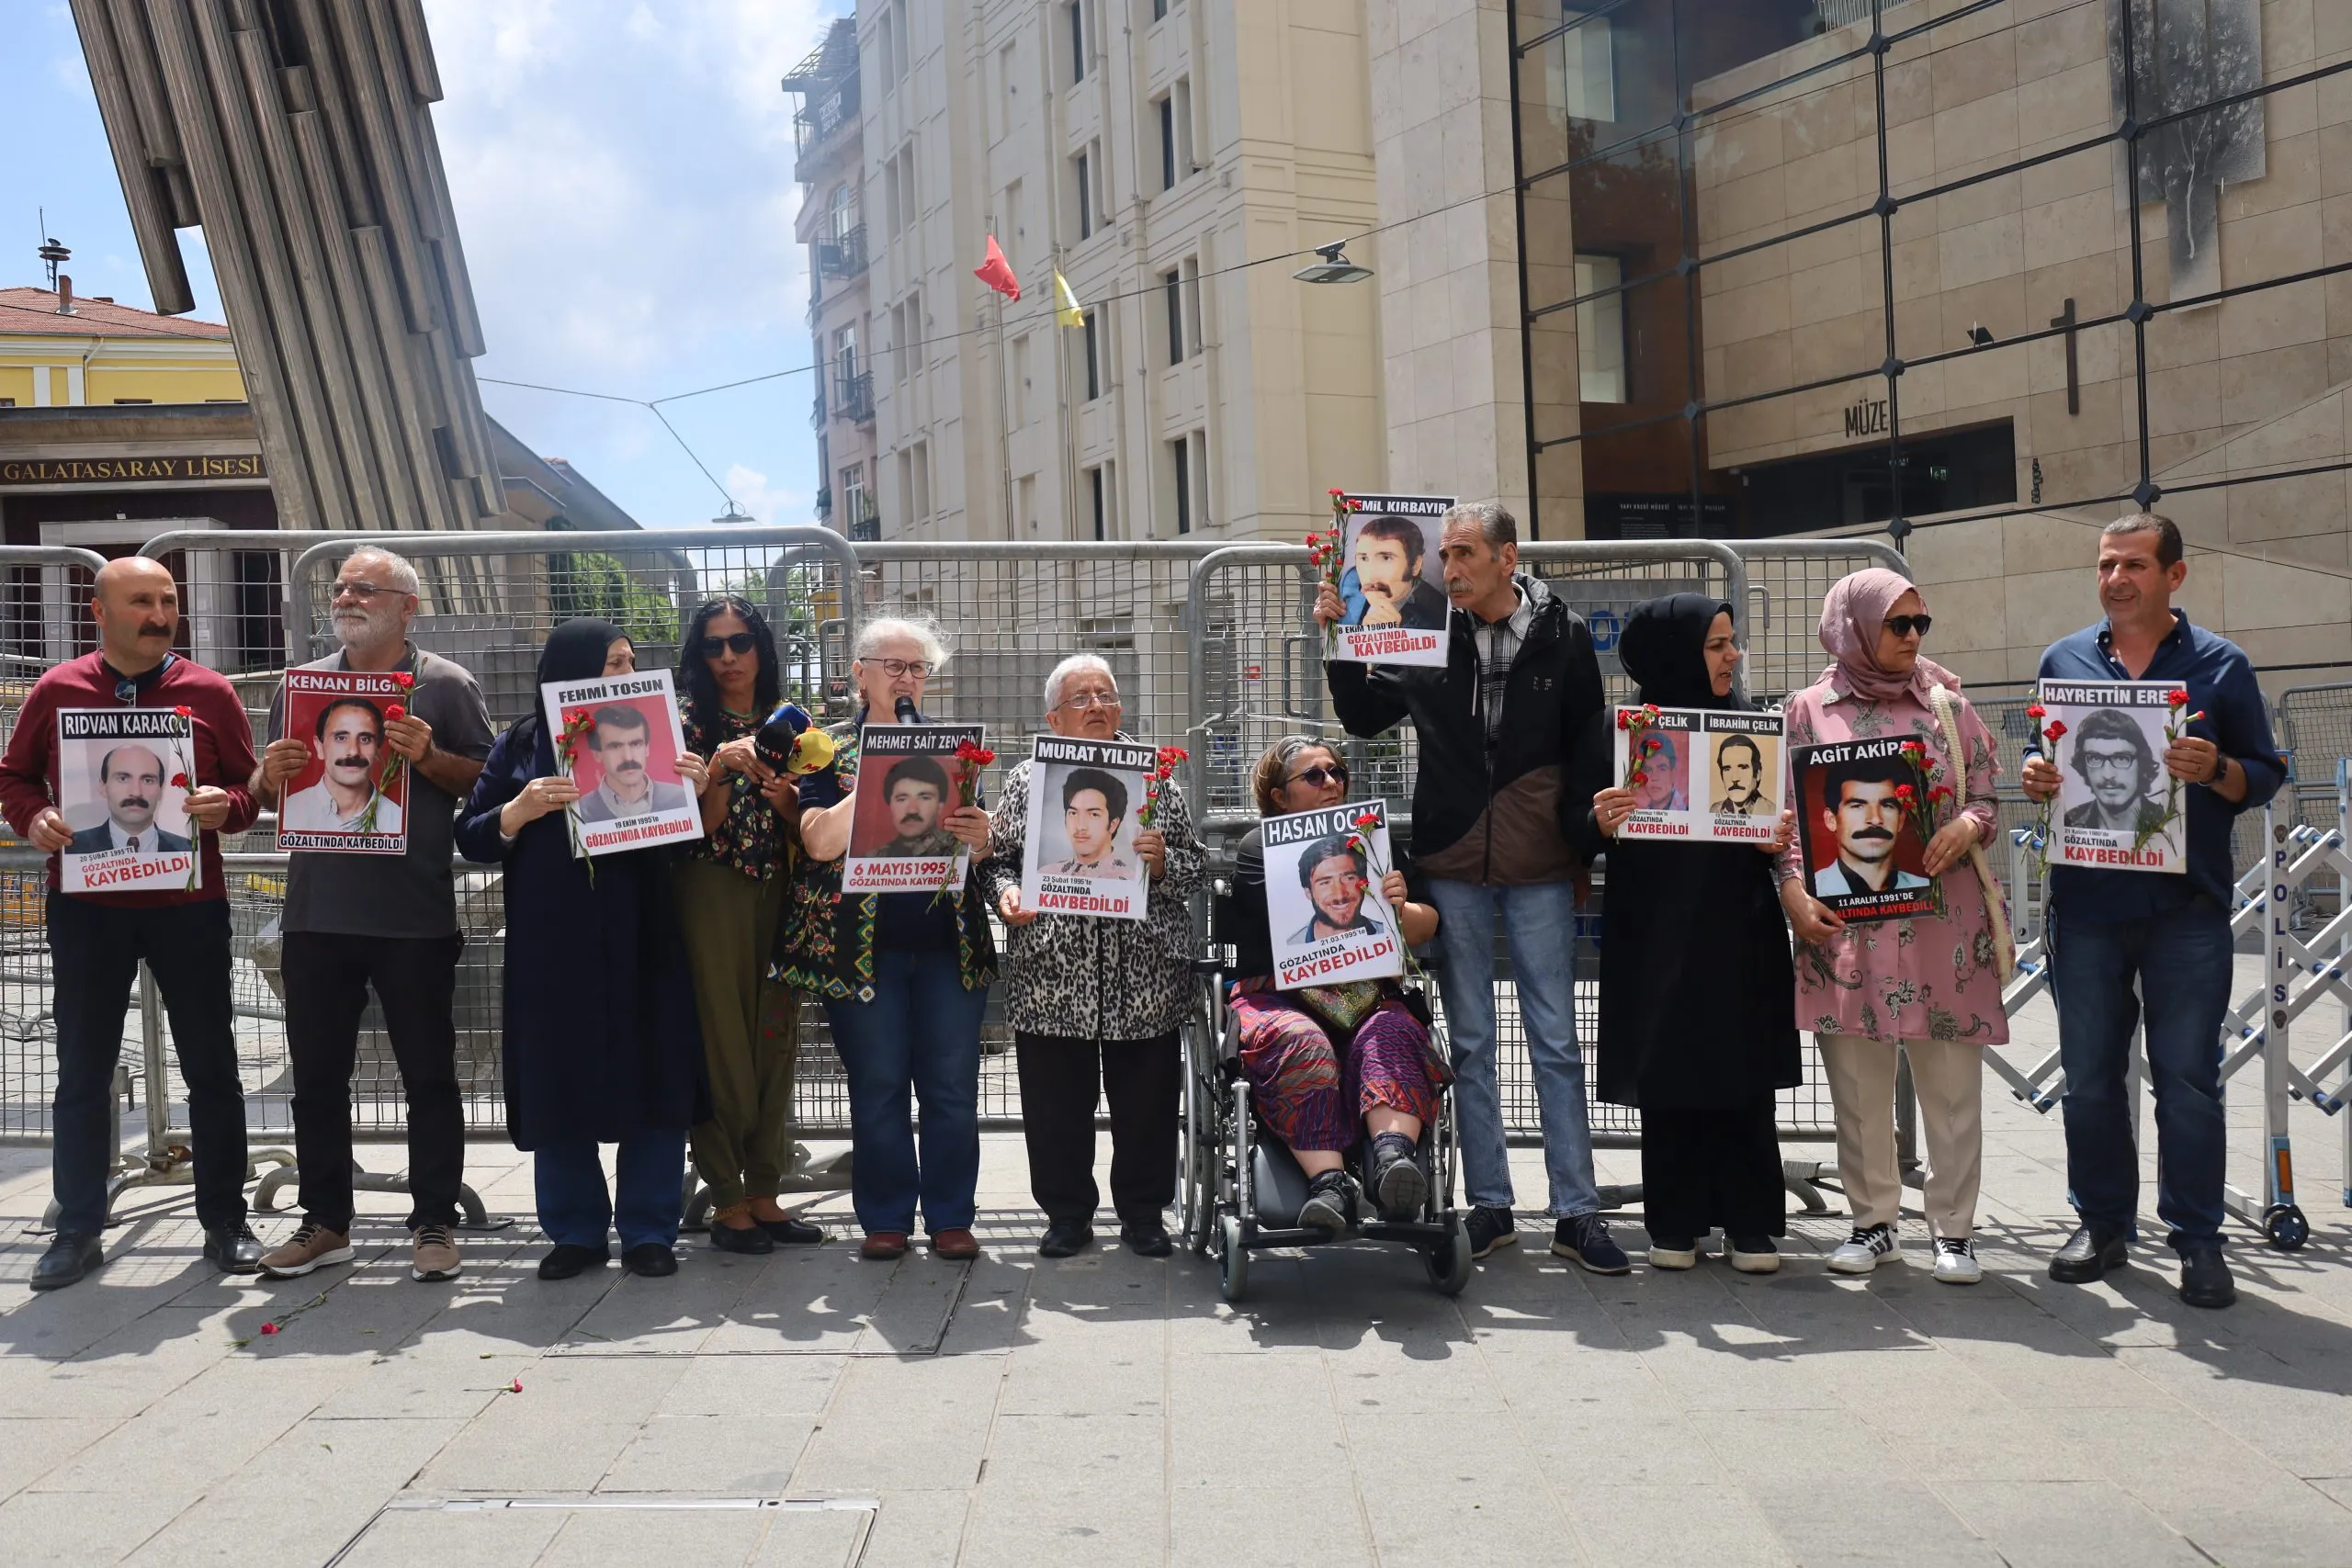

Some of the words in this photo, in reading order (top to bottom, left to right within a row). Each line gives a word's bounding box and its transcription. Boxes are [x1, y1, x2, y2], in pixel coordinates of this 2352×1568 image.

[1845, 398, 1888, 438] MÜZE
[4, 459, 177, 480] GALATASARAY
[186, 455, 258, 476] LİSESİ
[1386, 501, 1447, 513] KIRBAYIR
[1347, 630, 1408, 644] GÖZALTINDA
[288, 675, 349, 690] KENAN
[356, 675, 401, 692] BİLG
[559, 684, 607, 703] FEHMİ
[610, 679, 663, 695] TOSUN
[2045, 686, 2131, 704] HAYRETTİN
[2136, 690, 2168, 704] ERE
[65, 716, 118, 735] RIDVAN
[123, 714, 187, 737] KARAKOÇ
[1657, 715, 1688, 728] ÇELİK
[1709, 716, 1749, 729] İBRAHİM
[1752, 719, 1779, 732] ÇELİK
[866, 735, 910, 749] MEHMET
[914, 731, 934, 749] SAİT
[1037, 741, 1097, 762] MURAT
[1101, 747, 1153, 767] YILDIZ
[1810, 745, 1851, 764] AGİT
[1628, 815, 1663, 823] GÖZALTINDA
[1714, 818, 1747, 826] GÖZALTINDA
[586, 828, 640, 848] GÖZALTINDA
[641, 817, 694, 840] KAYBEDİLDİ
[1269, 813, 1329, 844] HASAN
[1627, 821, 1689, 835] KAYBEDİLDİ
[1713, 824, 1770, 839] KAYBEDİLDİ
[280, 833, 344, 848] GÖZALTINDA
[346, 835, 402, 850] KAYBEDİLDİ
[2064, 835, 2118, 847] GÖZALTINDA
[2064, 846, 2164, 866] KAYBEDİLDİ
[85, 852, 190, 888] KAYBEDİLDİ
[854, 863, 864, 876] 6
[849, 877, 907, 886] GÖZALTINDA
[910, 874, 960, 886] KAYBEDDİ
[1041, 883, 1091, 895] GÖZALTINDA
[1039, 894, 1129, 913] KAYBEDİLDİ
[1849, 897, 1878, 905] ARALIK
[1880, 892, 1914, 902] 1991'DE
[1279, 943, 1346, 969] GÖZALTINDA
[1283, 936, 1394, 985] KAYBEDİLDİ
